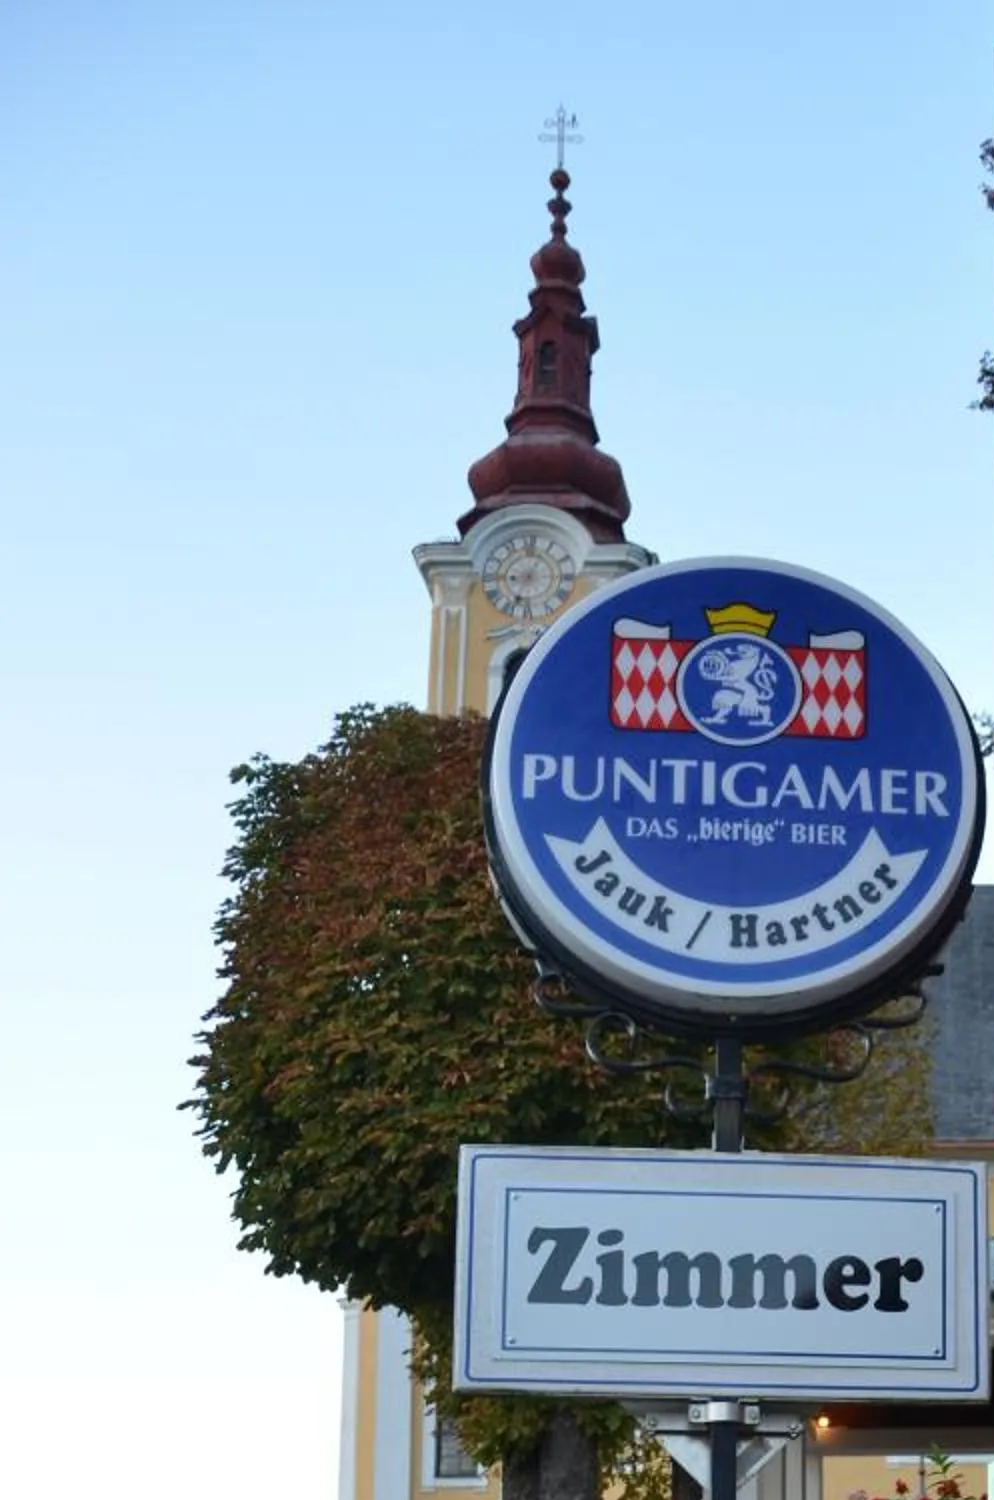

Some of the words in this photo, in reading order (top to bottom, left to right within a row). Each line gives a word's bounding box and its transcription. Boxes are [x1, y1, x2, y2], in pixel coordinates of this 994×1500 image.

[521, 753, 951, 818] PUNTIGAMER
[625, 816, 679, 840] DAS
[790, 823, 848, 846] BIER
[574, 849, 676, 934] Jauk
[728, 861, 899, 949] Hartner
[526, 1225, 925, 1314] Zimmer
